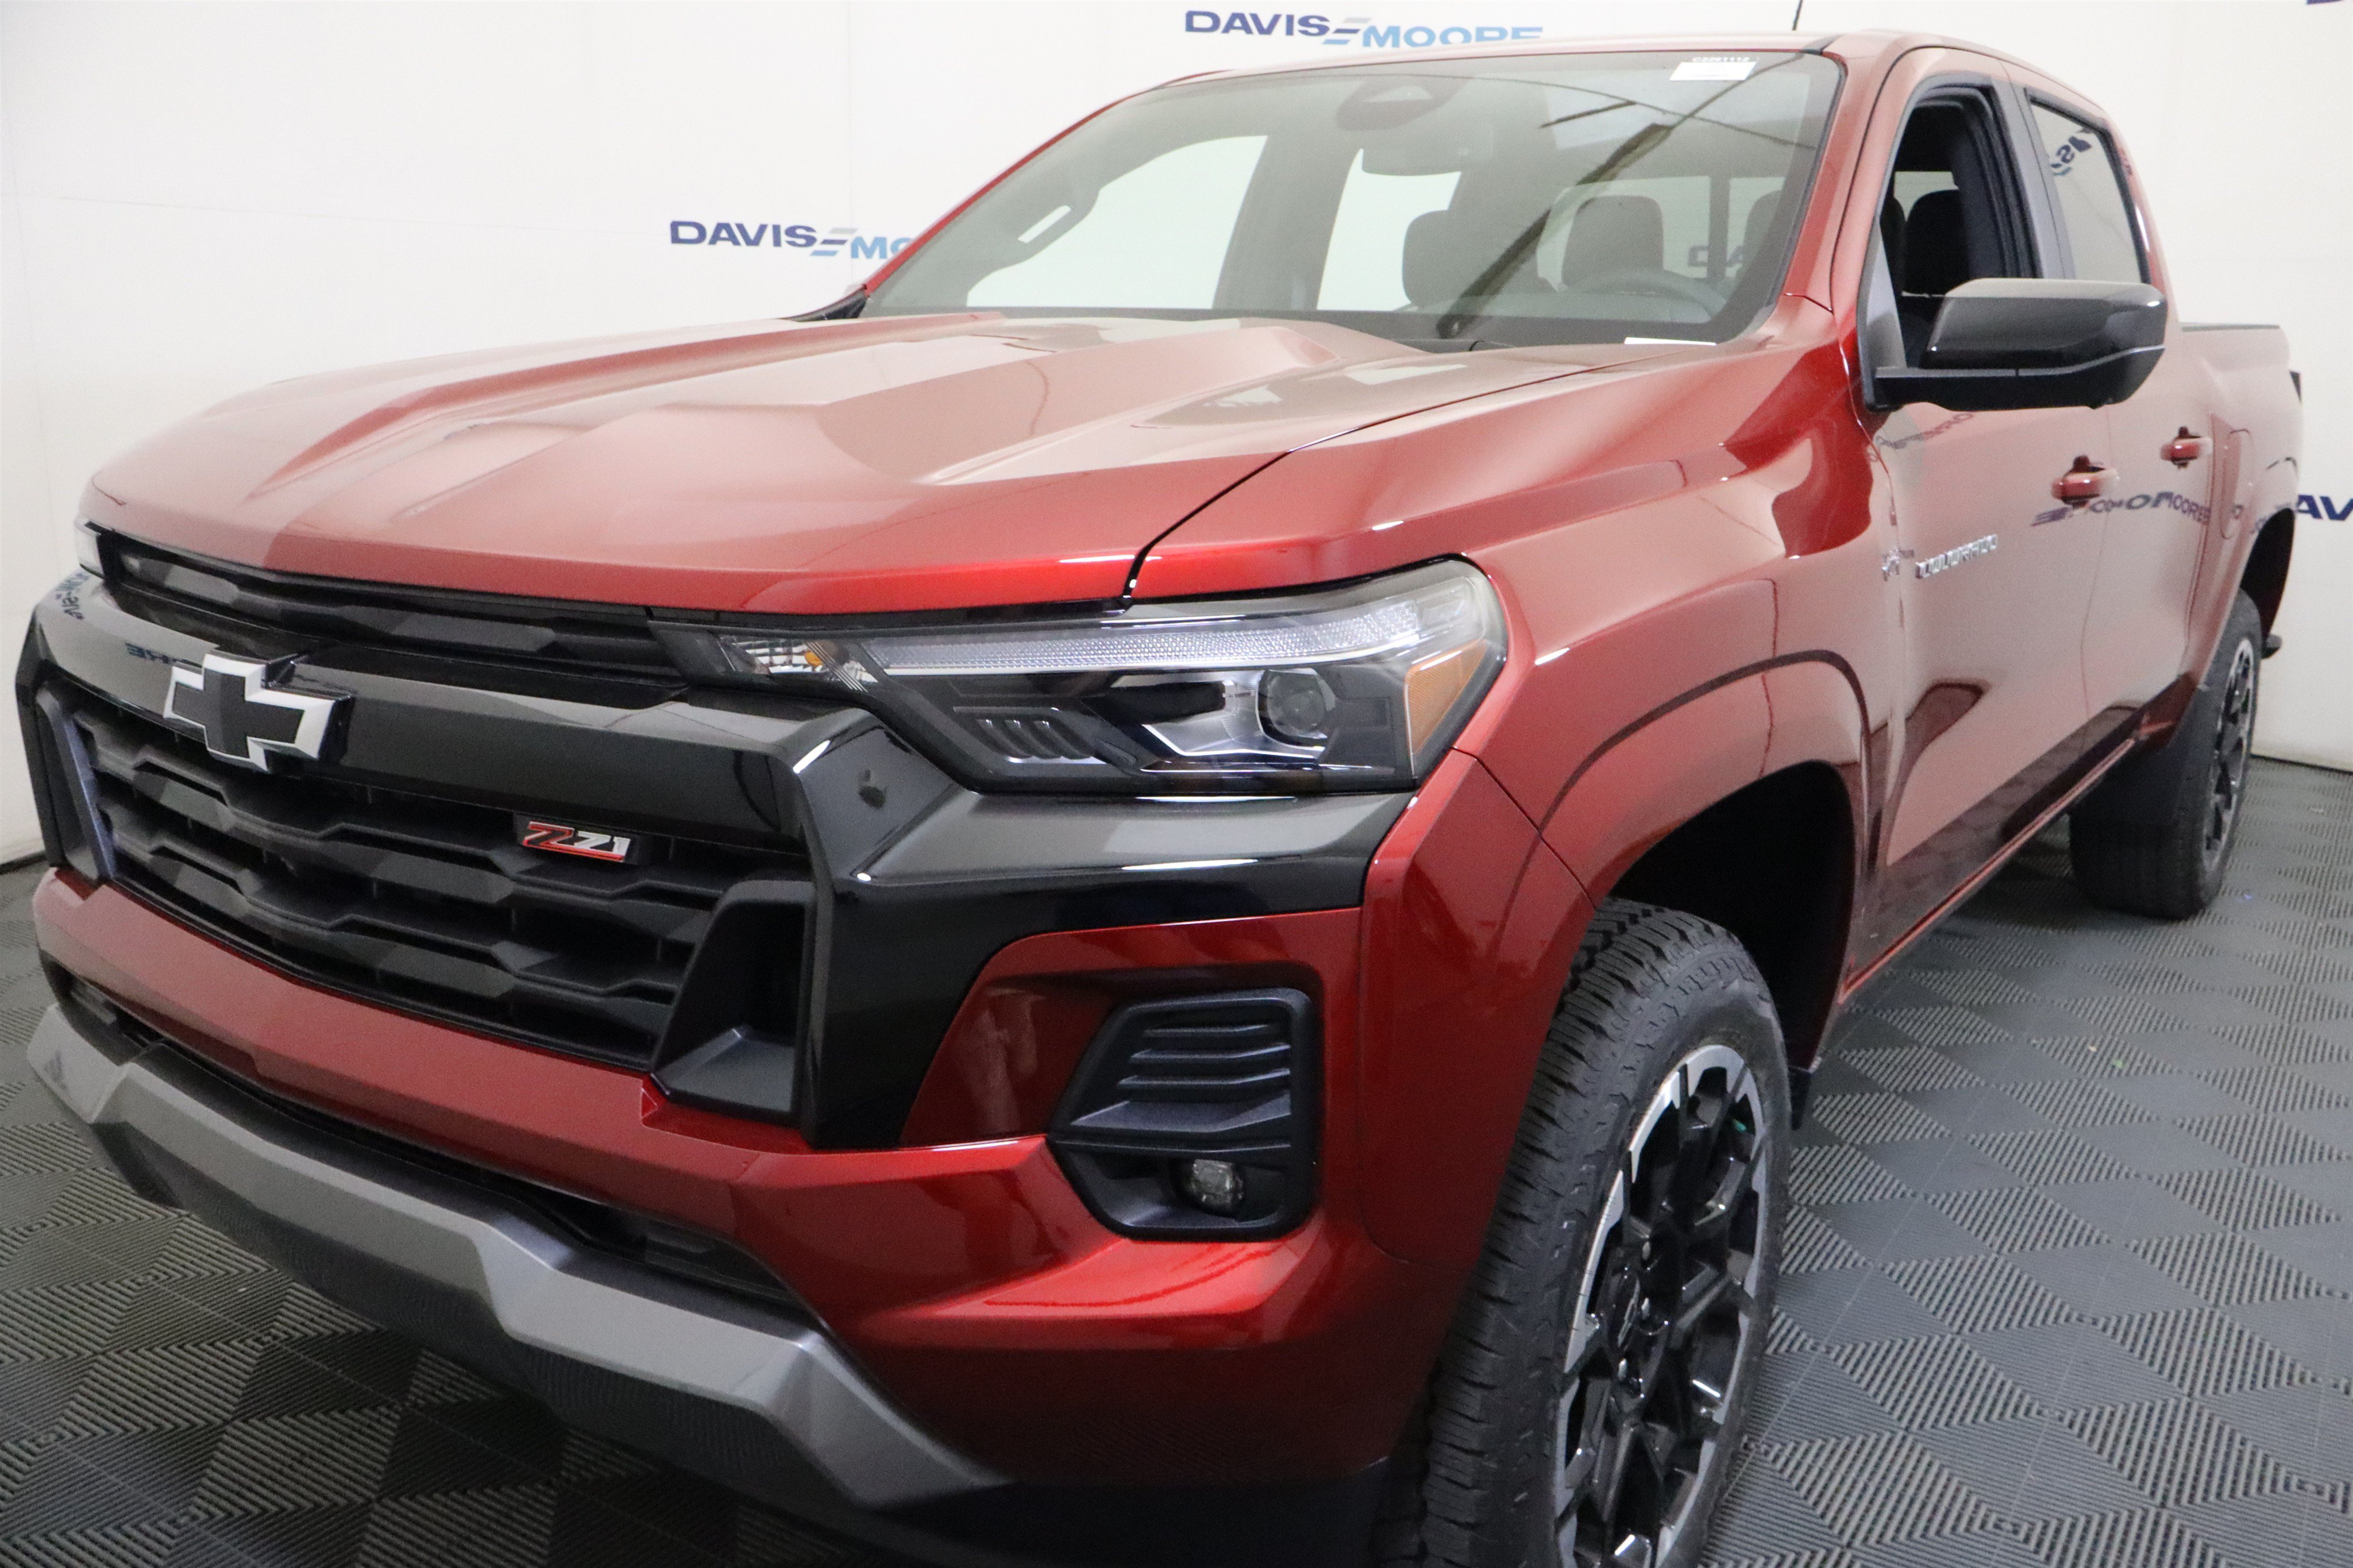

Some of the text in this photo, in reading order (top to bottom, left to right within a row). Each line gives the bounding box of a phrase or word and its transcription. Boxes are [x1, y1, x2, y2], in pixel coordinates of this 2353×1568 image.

[1185, 10, 1330, 37] DAVIS
[670, 221, 817, 248] DAVIS
[522, 821, 631, 862] Z71
